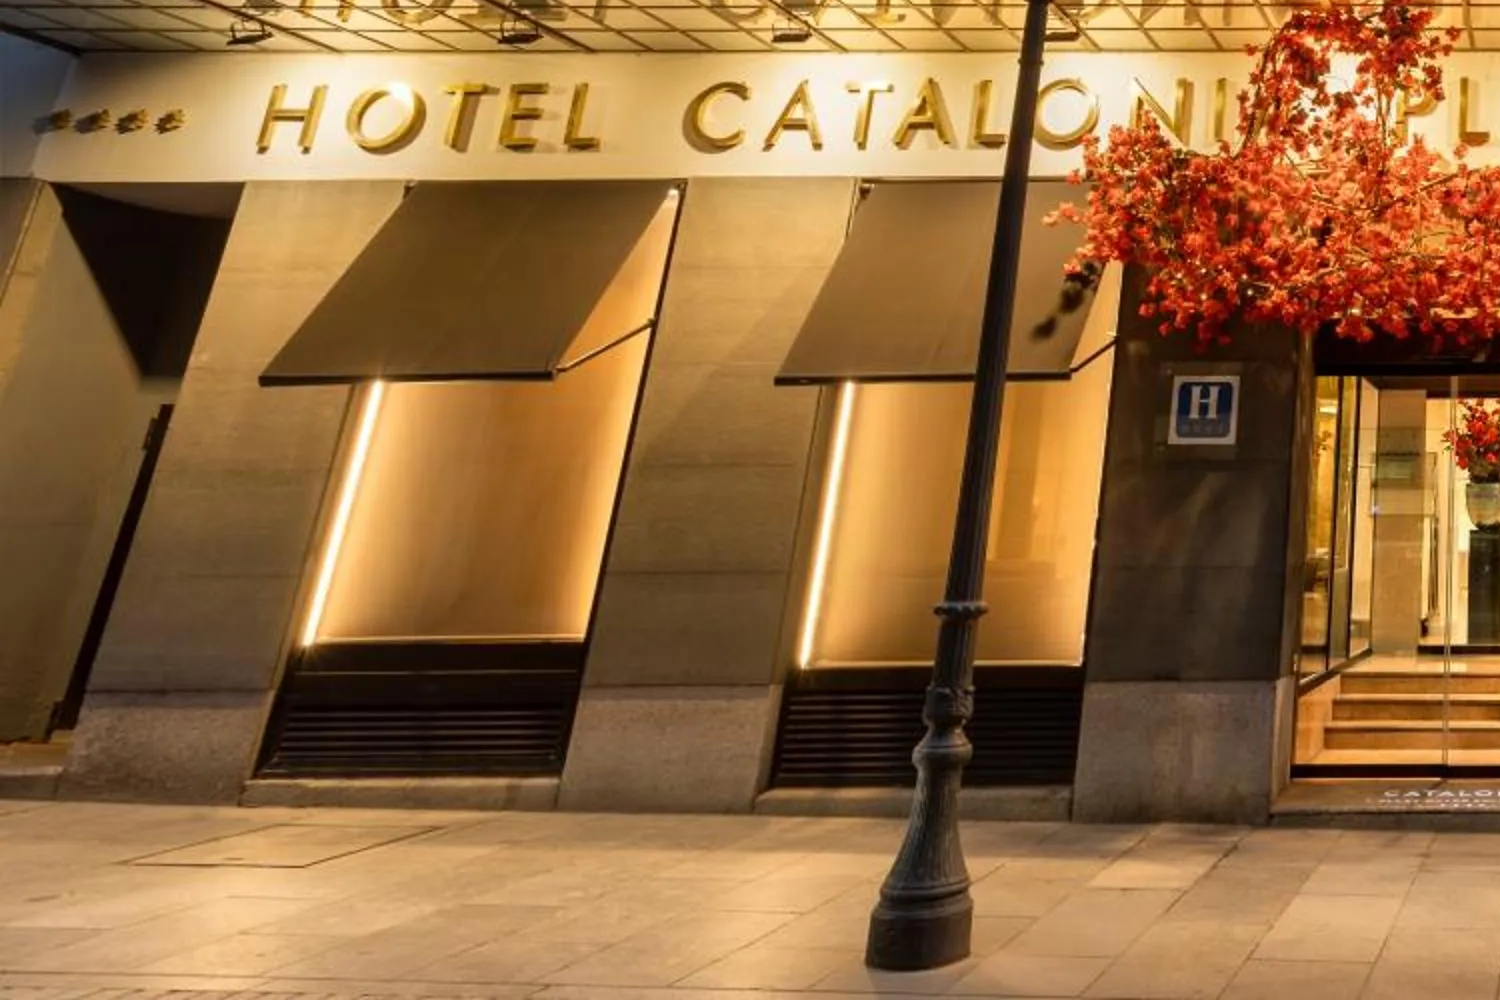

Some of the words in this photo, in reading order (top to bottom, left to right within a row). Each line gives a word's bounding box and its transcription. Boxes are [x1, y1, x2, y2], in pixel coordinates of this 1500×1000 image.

[256, 81, 601, 155] HOTEL
[685, 77, 1272, 153] CATALONI
[1187, 384, 1222, 420] H
